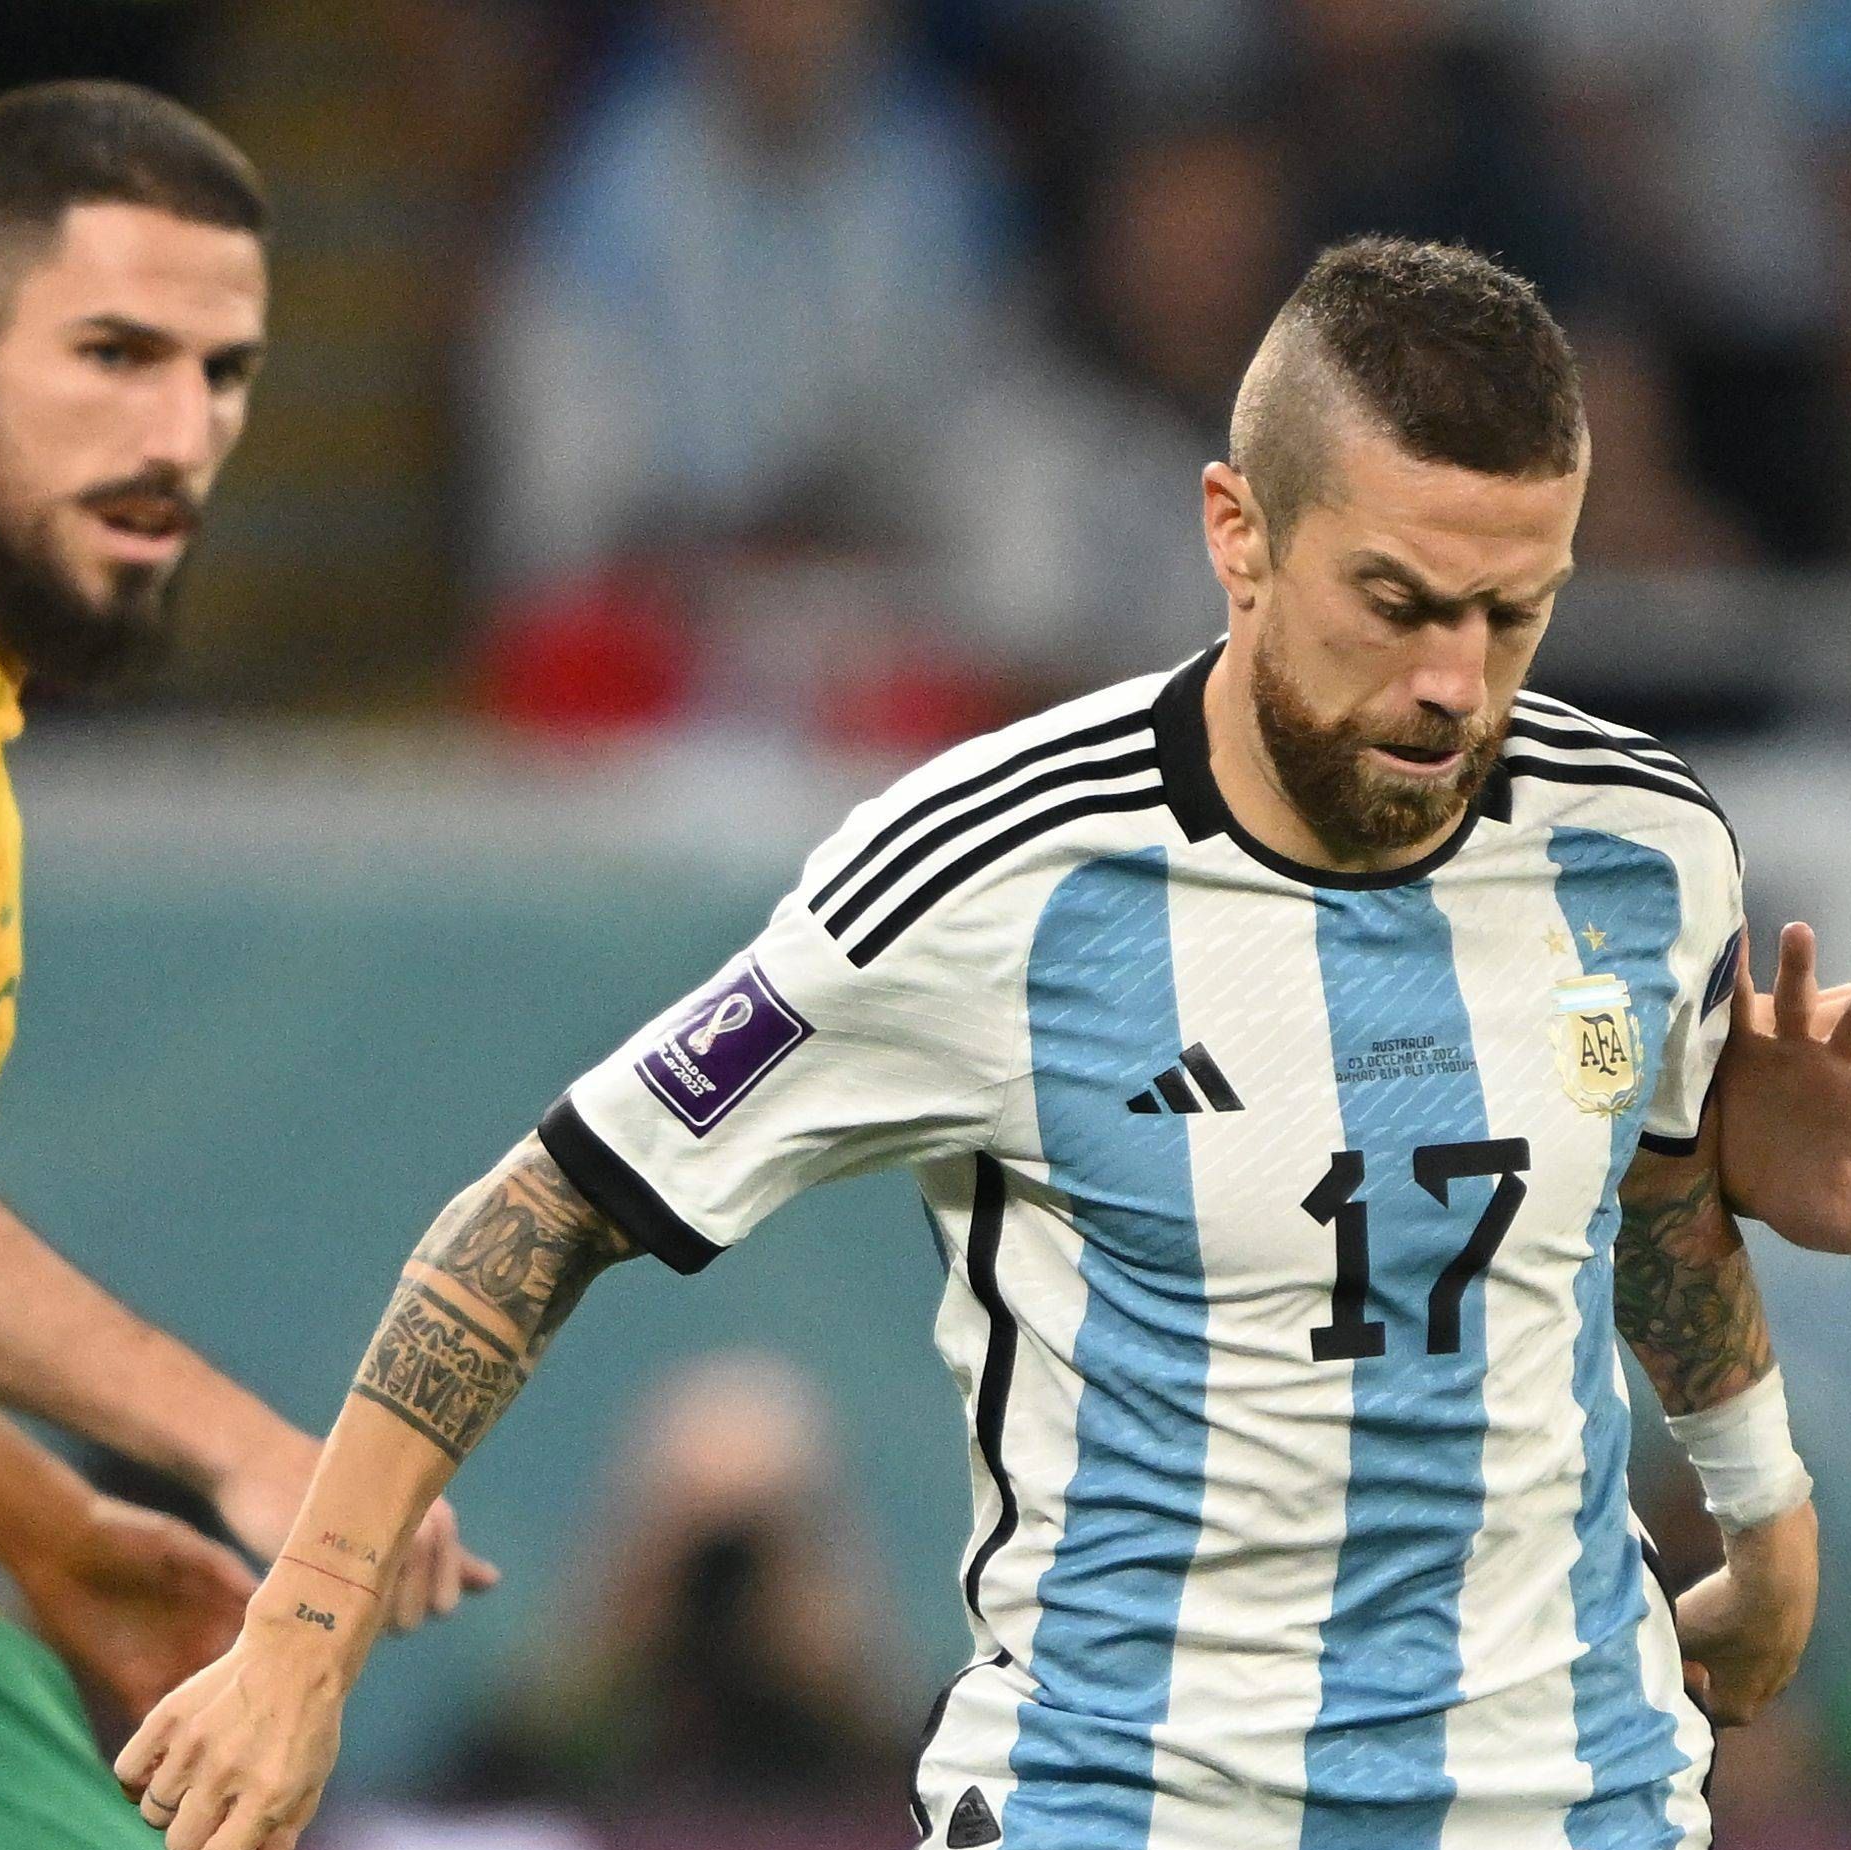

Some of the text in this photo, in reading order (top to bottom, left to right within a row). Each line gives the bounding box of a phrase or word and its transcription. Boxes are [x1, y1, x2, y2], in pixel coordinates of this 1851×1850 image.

[1372, 1035, 1435, 1052] AUSTRALIA
[1580, 1013, 1628, 1076] AFA
[1348, 1047, 1461, 1069] 03 DECEMBER 2022
[697, 1071, 717, 1092] CUP
[1336, 1059, 1479, 1083] AHMAD BIN ALI STADIUM
[1300, 1136, 1532, 1363] 17
